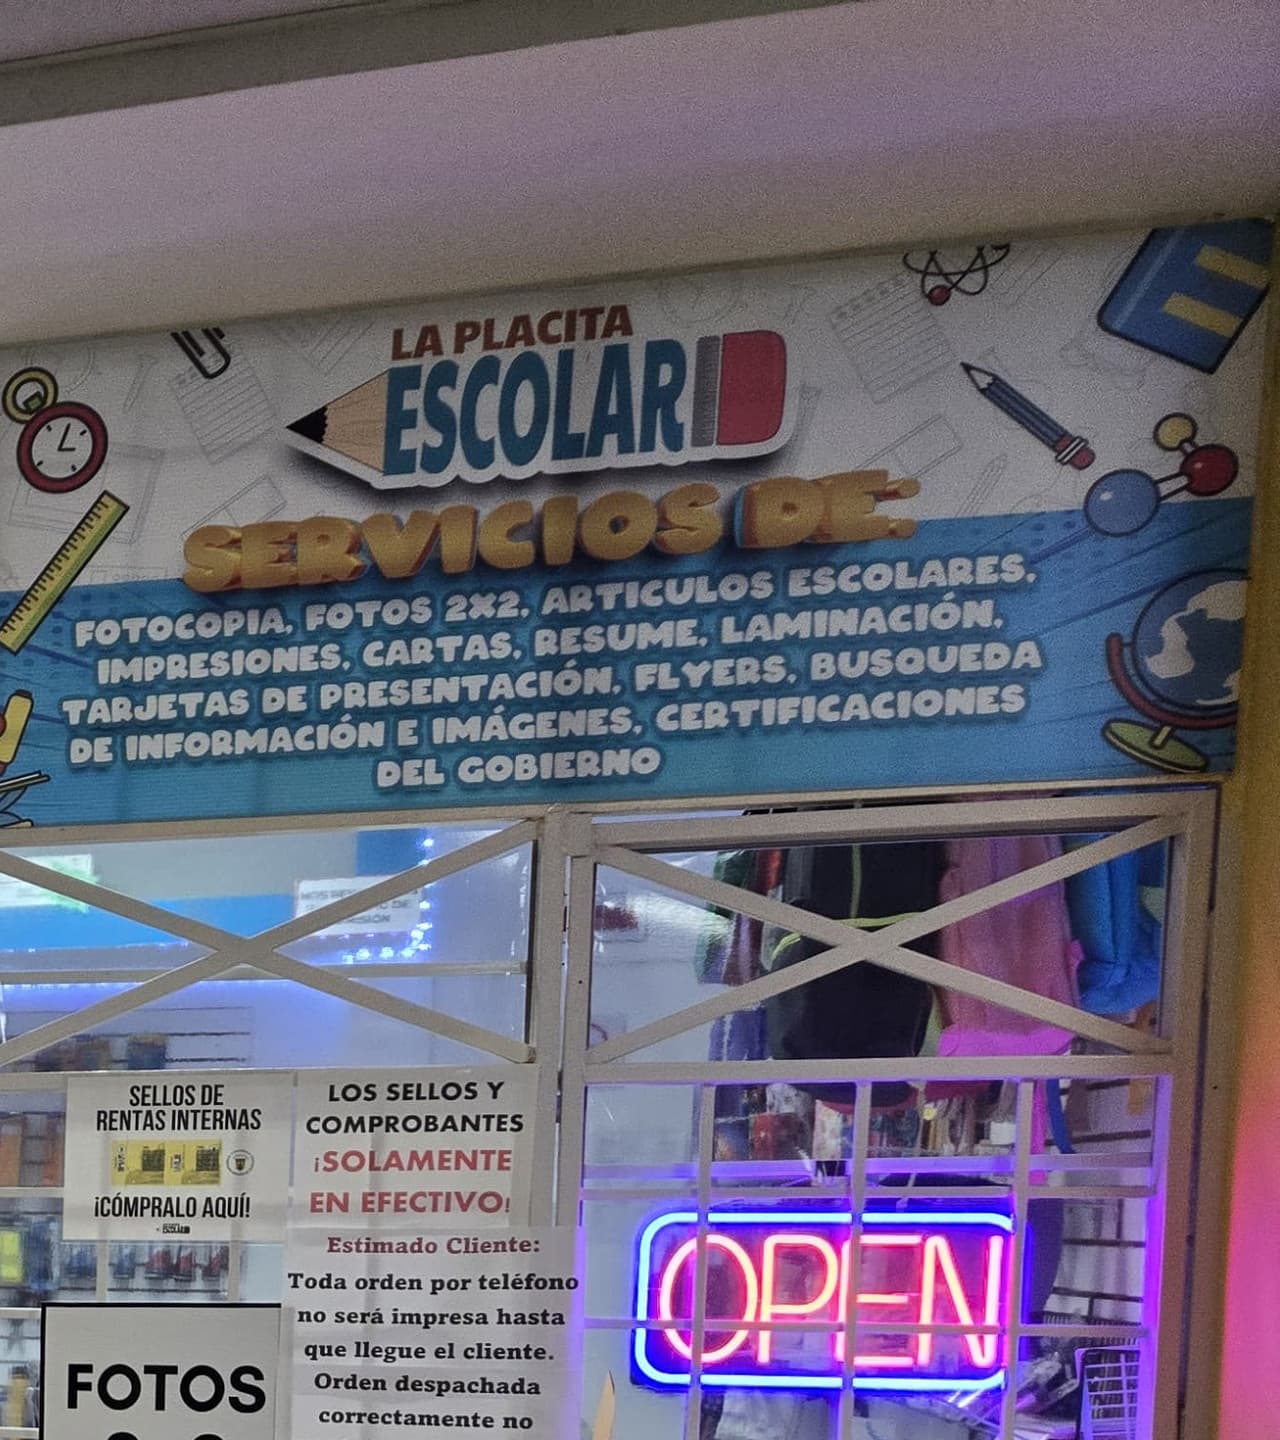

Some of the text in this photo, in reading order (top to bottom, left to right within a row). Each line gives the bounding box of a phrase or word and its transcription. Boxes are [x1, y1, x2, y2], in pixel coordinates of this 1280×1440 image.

[392, 305, 633, 361] LA PLACITA
[383, 338, 687, 476] ESCOLAR
[183, 468, 921, 594] SERVICIOS DE
[75, 610, 292, 648] FOTOCOPIA,
[306, 598, 432, 632] FOTOS
[542, 572, 771, 615] ARTICULOS
[788, 554, 1037, 596] ESCOLARES,
[98, 591, 1003, 685] IMPRESIONES, CARTAS, RESUME, LAMINACIÓN,
[62, 641, 1042, 725] TARJETAS DE PRESENTACIÓN, FLYERS, BUSQUEDA
[70, 685, 1026, 764] DE INFORMACIÓN E IMÁGENES, CERTIFICACIONES
[377, 747, 661, 788] DEL GOBIERNO
[129, 1085, 224, 1106] SELLOS DE
[328, 1082, 504, 1102] LOS SELLOS Y
[96, 1109, 261, 1131] RENTAS INTERNAS
[306, 1114, 523, 1134] COMPROBANTES
[314, 1150, 512, 1173] ¡SOLAMENTE
[94, 1194, 250, 1218] ¡CÓMPRALO AQUÍ!
[310, 1192, 352, 1214] EN
[327, 1237, 539, 1254] Estimado Cliente:
[288, 1272, 579, 1295] Toda orden por teléfono
[658, 1233, 1003, 1367] OPEN
[297, 1308, 565, 1329] no será impresa hasta
[304, 1342, 554, 1362] que llegue el cliente.
[67, 1363, 266, 1413] FOTOS
